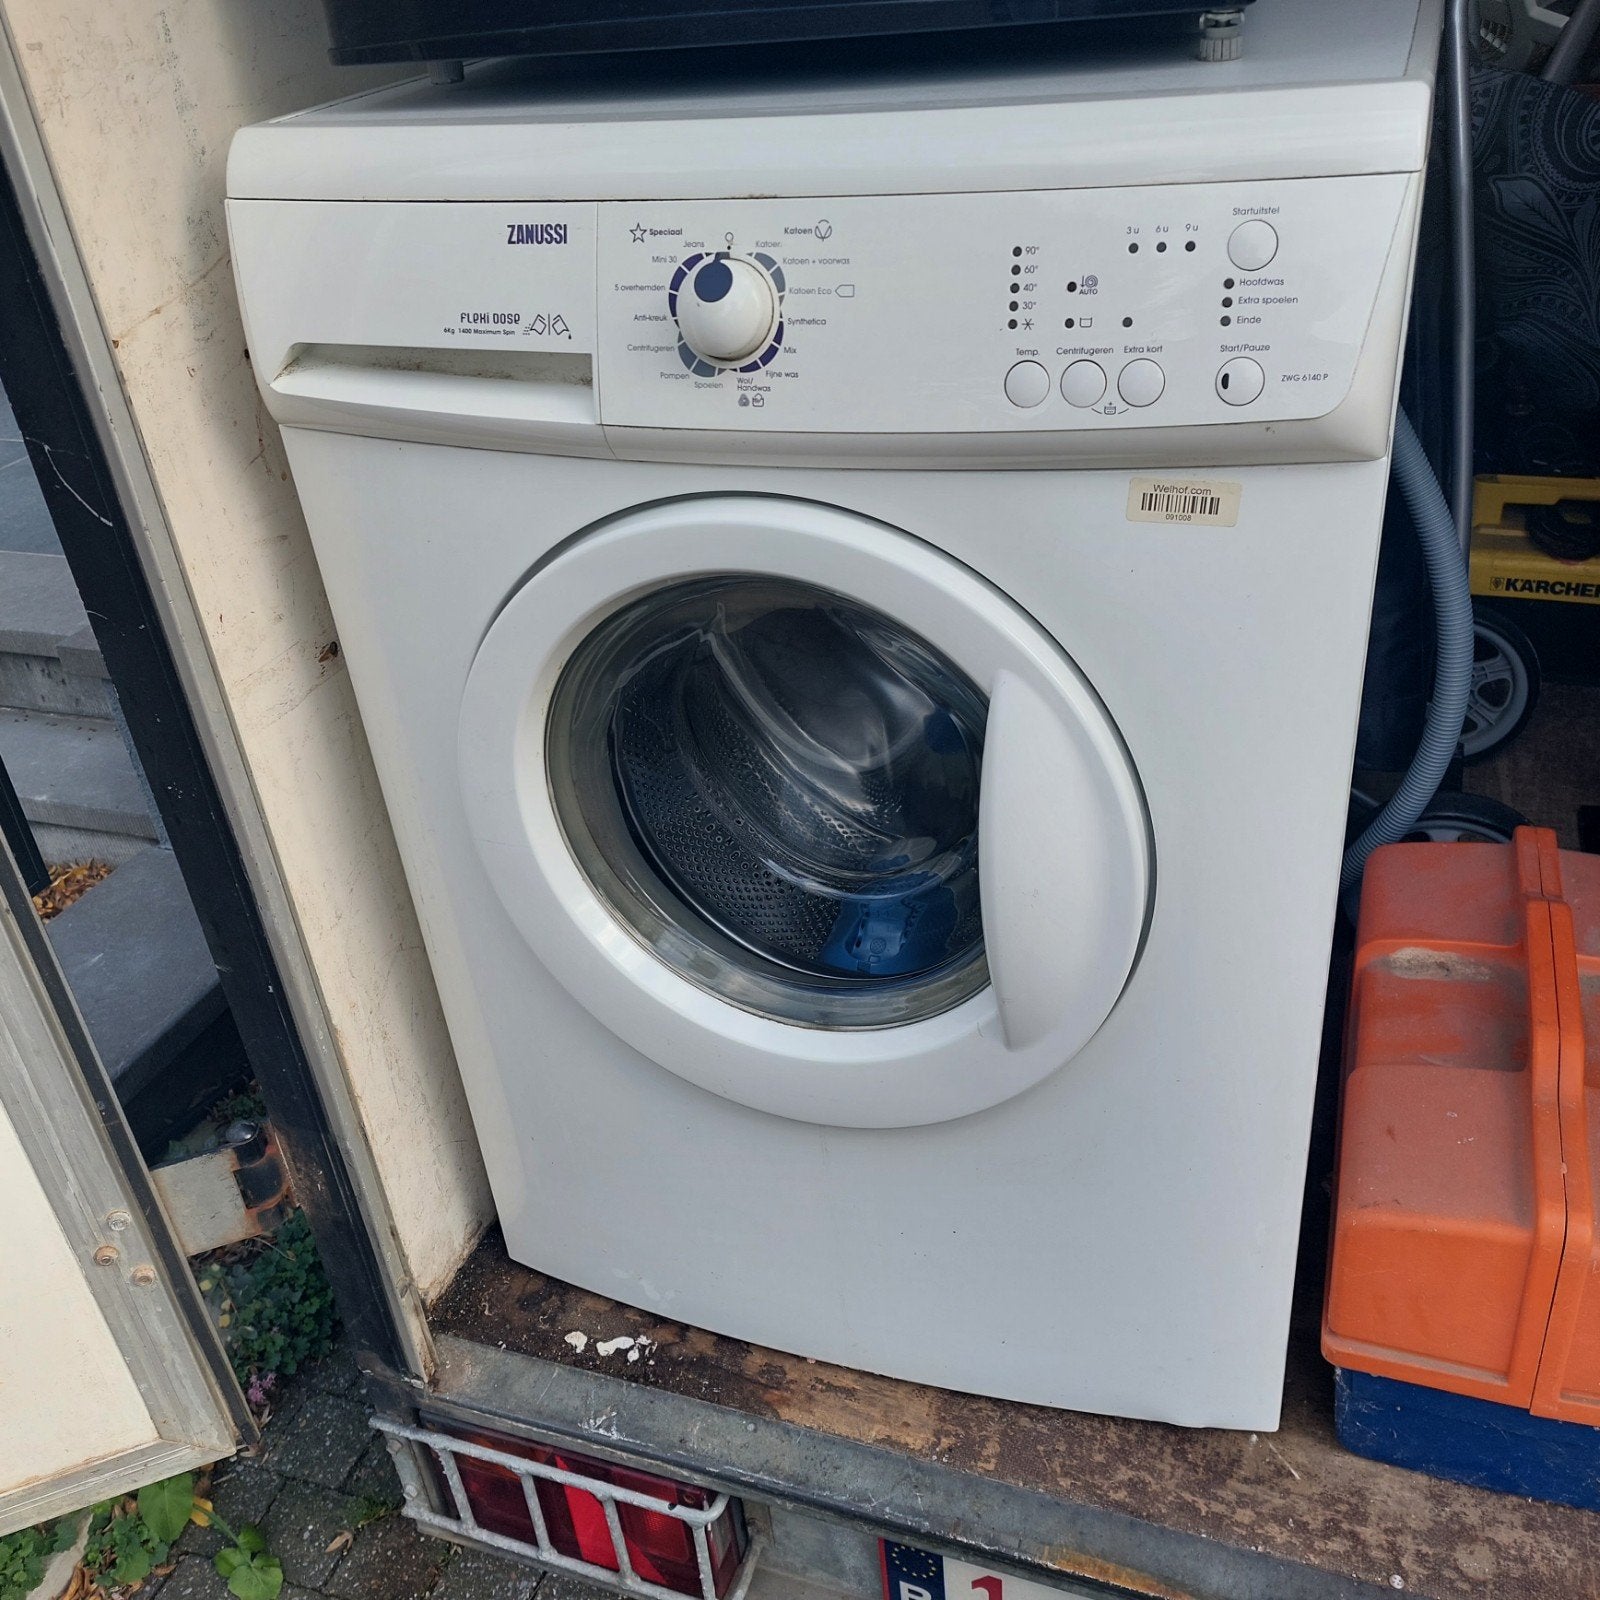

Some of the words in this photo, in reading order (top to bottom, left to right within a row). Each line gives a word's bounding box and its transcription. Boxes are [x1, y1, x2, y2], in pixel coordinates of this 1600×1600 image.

[1232, 206, 1280, 216] Startuitstel
[784, 227, 812, 235] Katoen
[1126, 226, 1133, 235] 3
[1155, 224, 1162, 233] 6
[1162, 225, 1169, 233] u
[1185, 223, 1192, 232] 9
[507, 224, 567, 245] ZANUSSI
[649, 228, 682, 237] Speciaal
[652, 255, 667, 263] Mini
[782, 257, 809, 265] Katoen
[1239, 277, 1285, 286] Hoofdwas
[620, 283, 666, 291] overhemden
[789, 287, 816, 295] Katoen
[817, 287, 832, 295] Eco
[1238, 296, 1260, 305] Extra
[1261, 296, 1299, 306] spoelen
[787, 317, 826, 326] Synthetica
[1236, 315, 1262, 324] Einde
[627, 344, 675, 353] Centrifugeren
[1056, 346, 1114, 356] Centrifugeren
[1123, 345, 1145, 354] Extra
[1146, 345, 1164, 353] kort
[1220, 343, 1270, 352] Start/Pauze
[660, 371, 690, 380] Pompen
[765, 370, 783, 379] Fijne
[1281, 374, 1300, 382] ZWG
[1301, 373, 1321, 381] 6140
[694, 381, 724, 390] Spoelen
[737, 384, 771, 392] Handwas
[1153, 484, 1212, 496] Welhof.com
[1165, 513, 1192, 522] 091008
